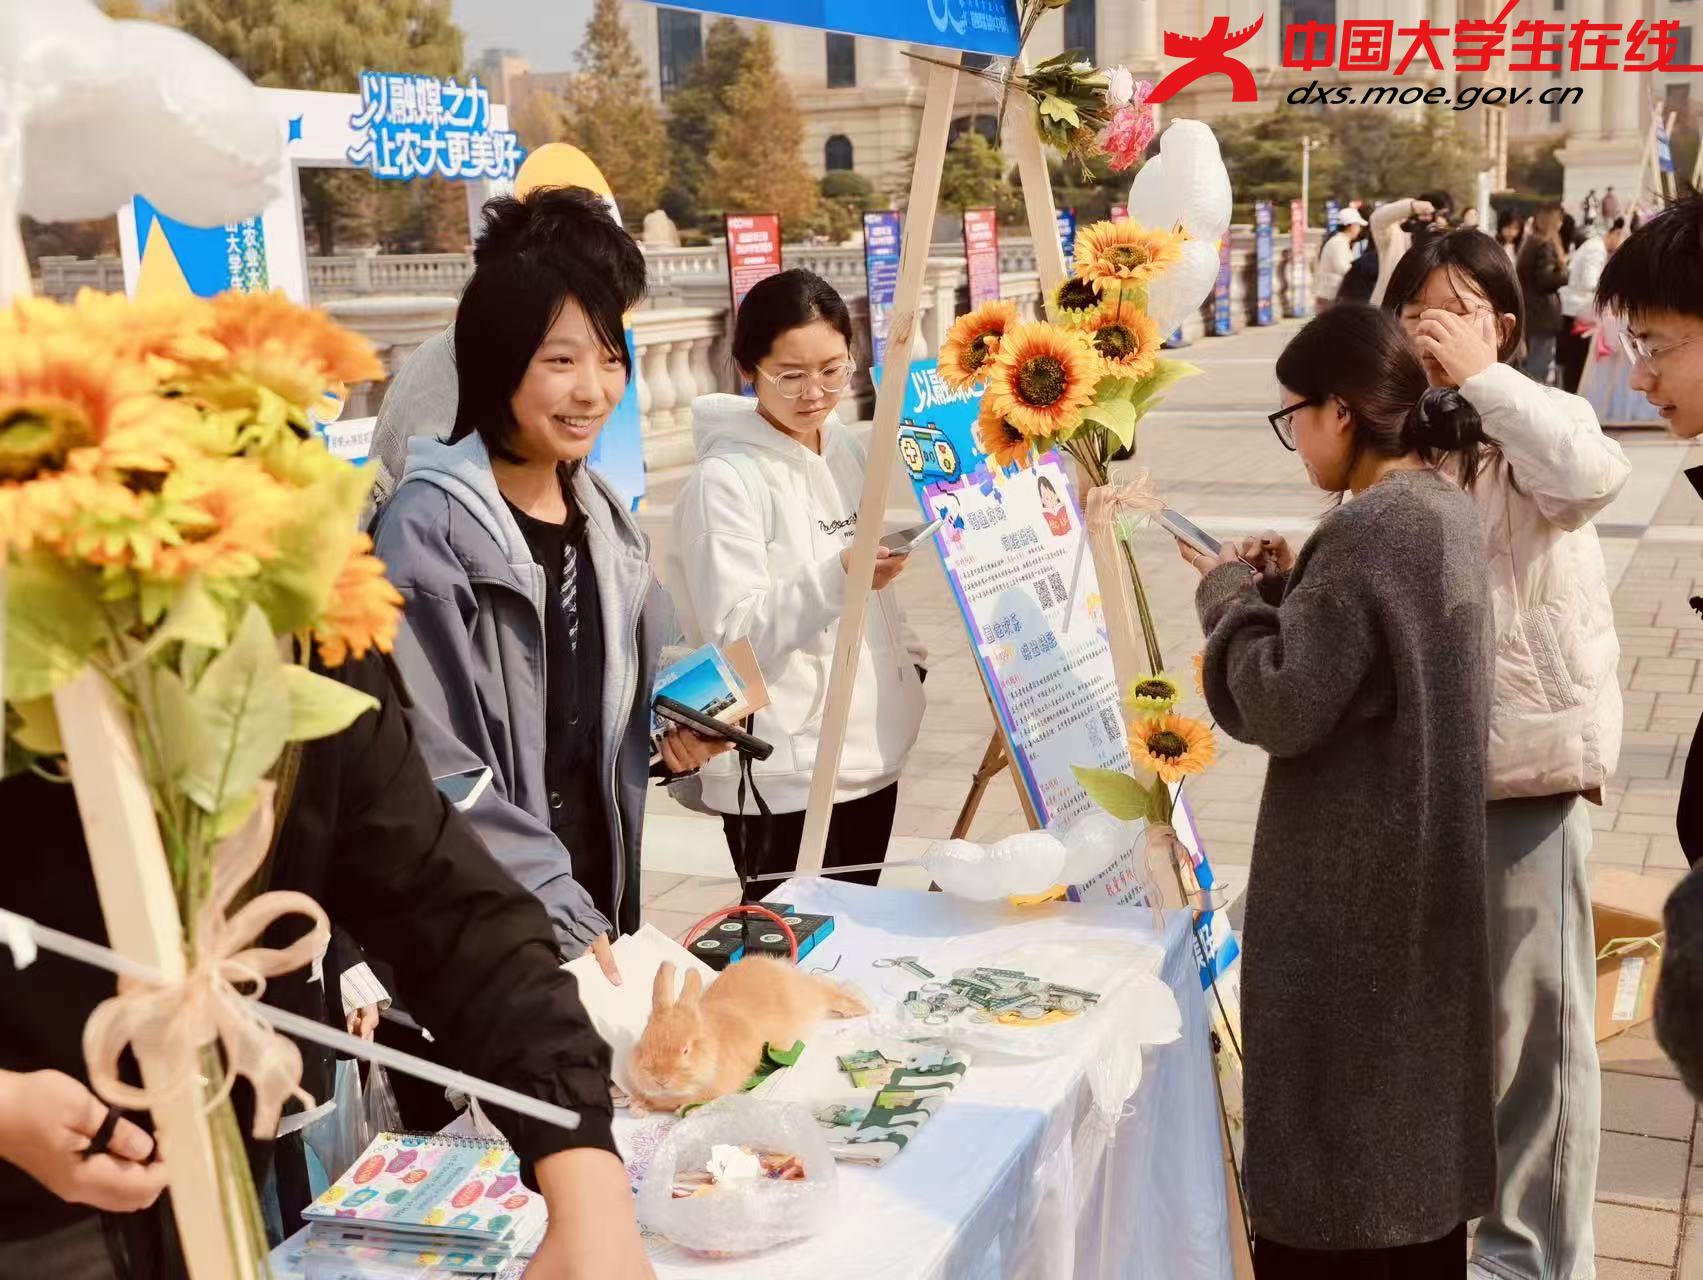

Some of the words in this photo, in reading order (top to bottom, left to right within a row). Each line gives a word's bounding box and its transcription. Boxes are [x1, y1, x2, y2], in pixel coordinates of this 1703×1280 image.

[350, 74, 491, 129] 以融媒之力
[347, 128, 522, 179] 让农大更美好
